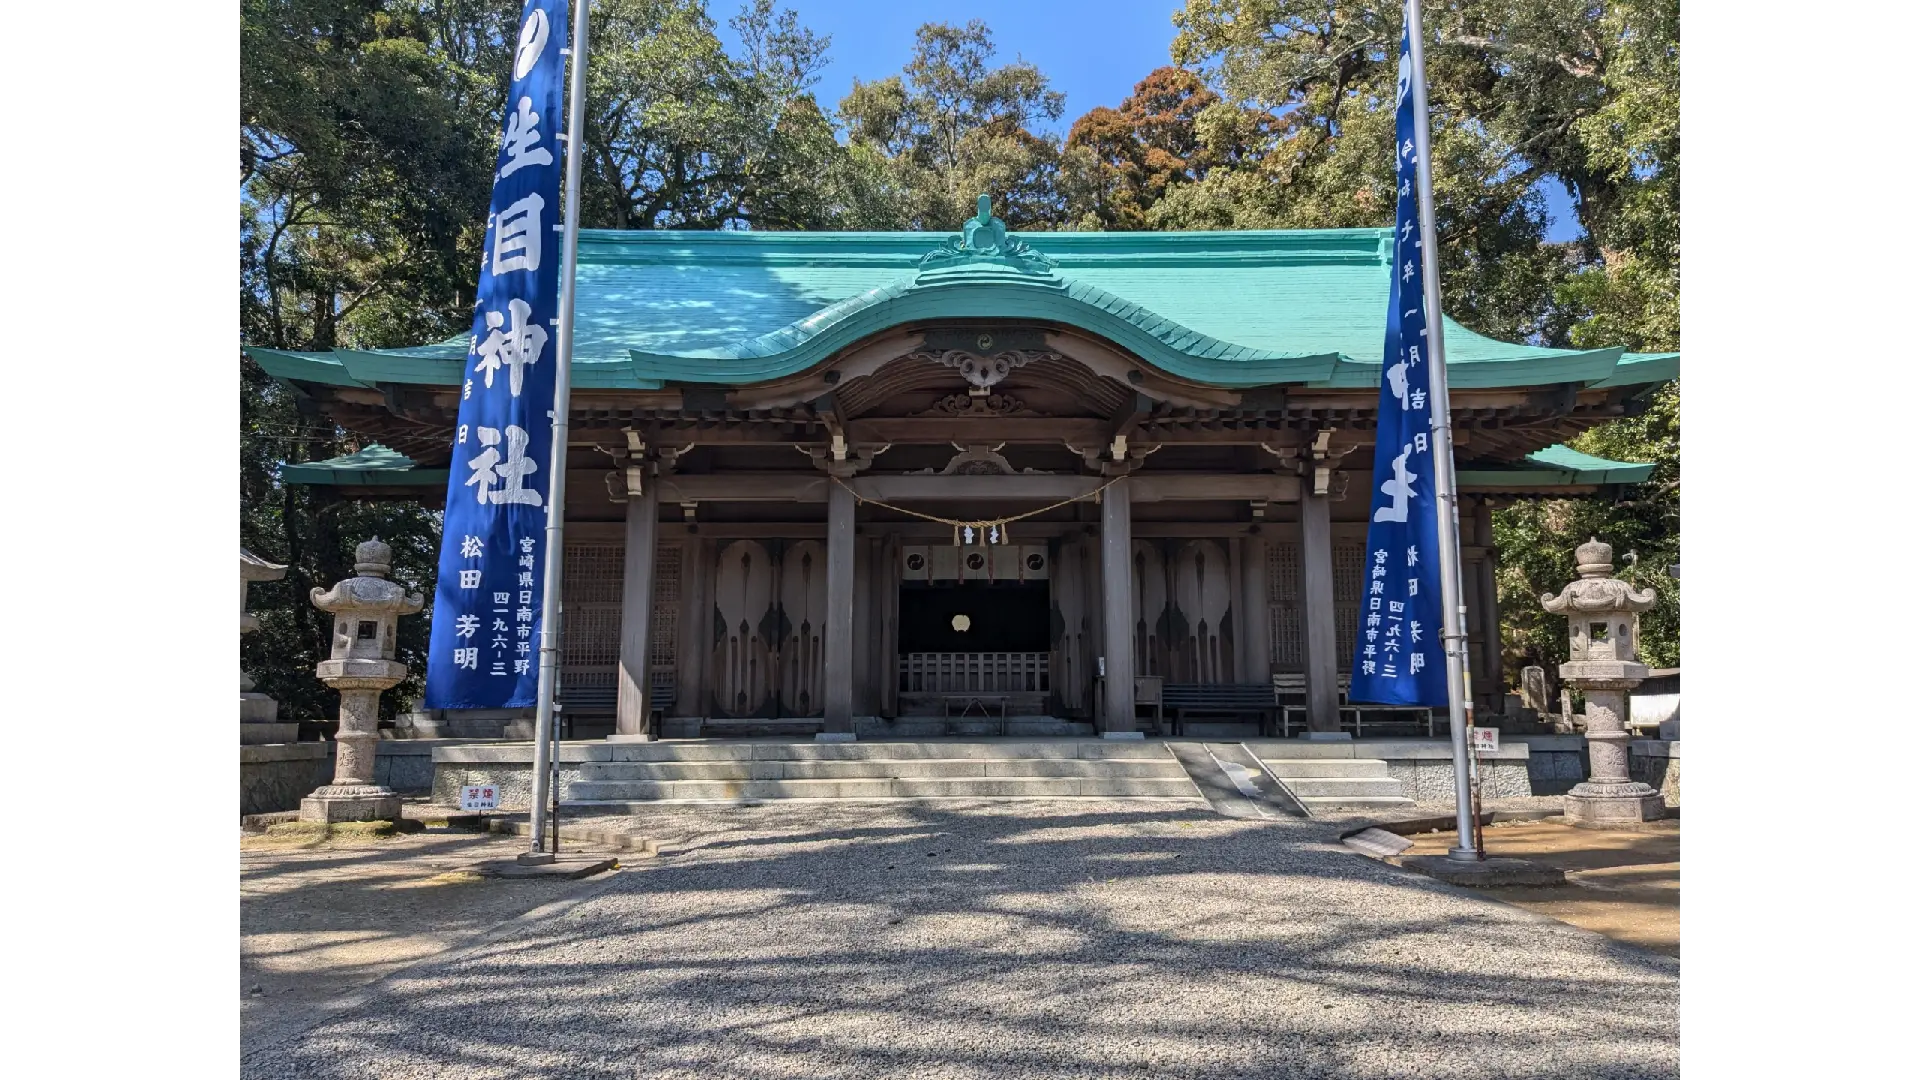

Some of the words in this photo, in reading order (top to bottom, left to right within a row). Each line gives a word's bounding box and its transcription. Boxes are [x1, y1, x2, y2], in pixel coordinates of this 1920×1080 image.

[513, 536, 536, 676] 宮崎県日南市平野
[468, 788, 494, 800] 禁煙
